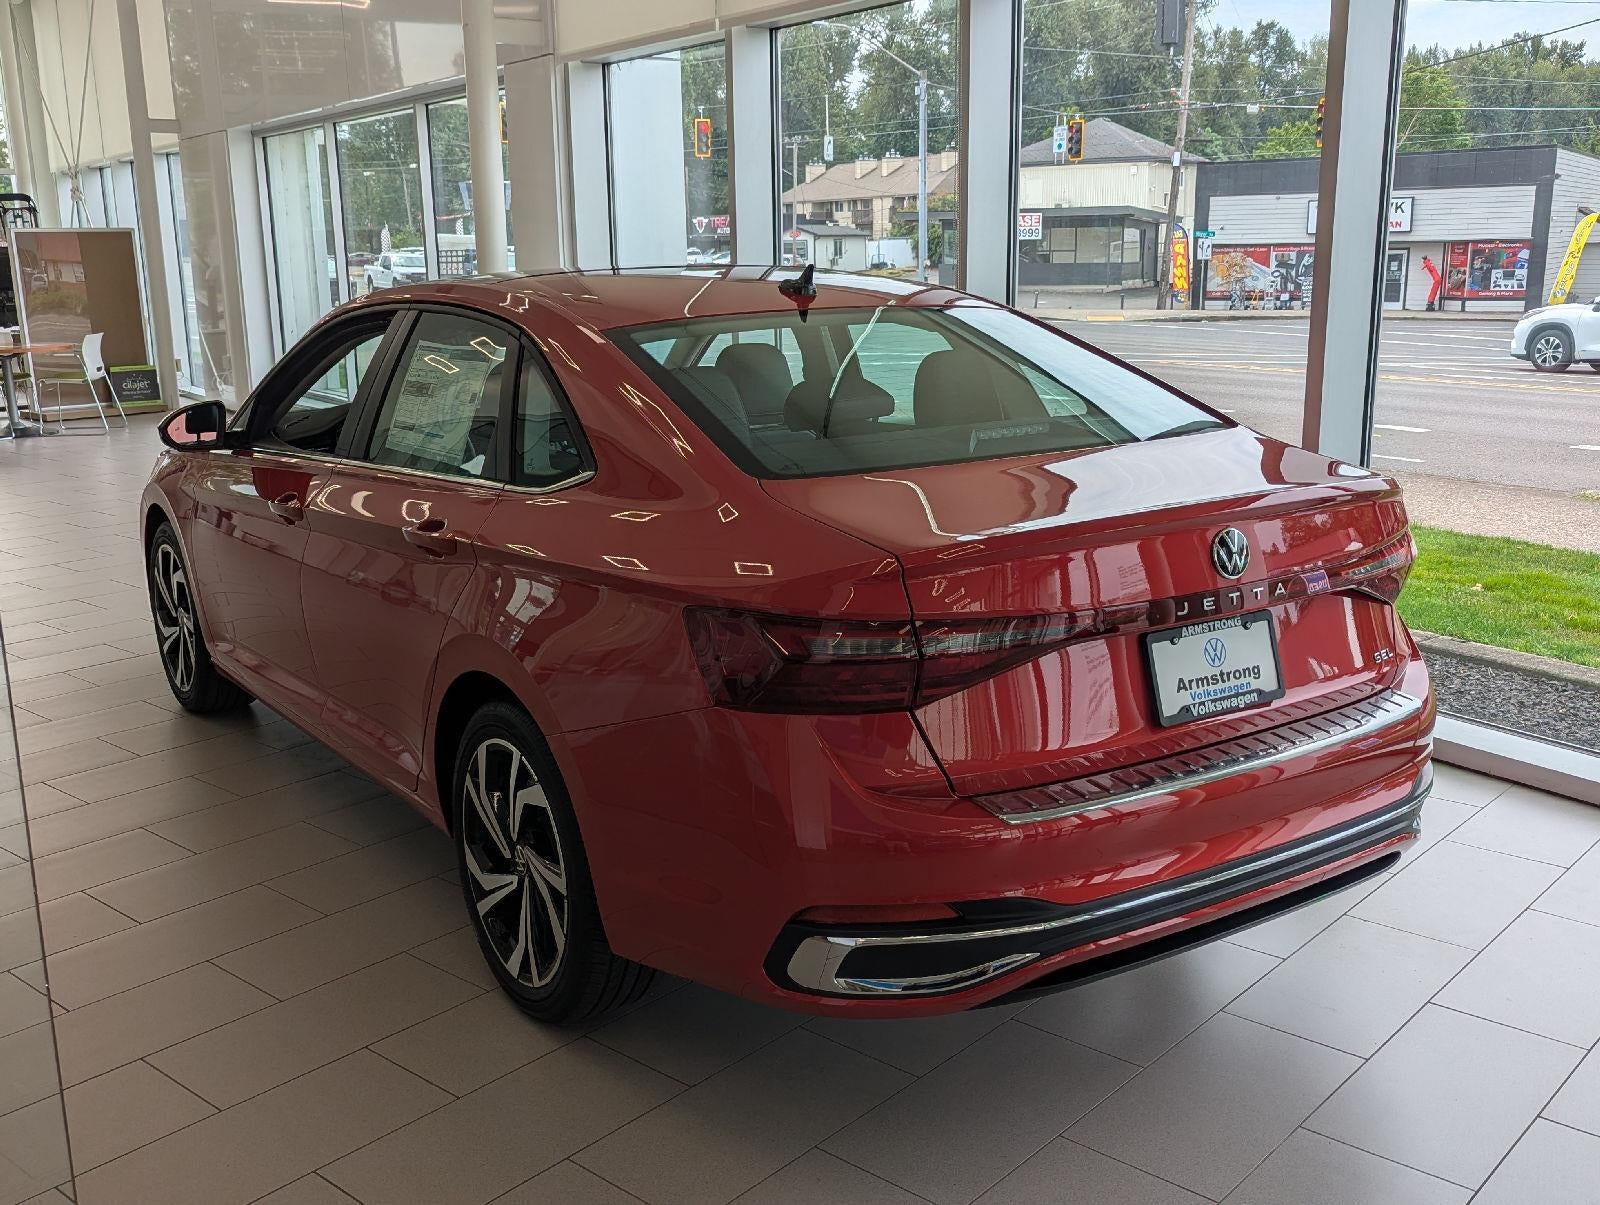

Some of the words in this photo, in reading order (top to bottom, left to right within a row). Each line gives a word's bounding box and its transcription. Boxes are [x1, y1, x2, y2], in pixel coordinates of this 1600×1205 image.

[1391, 201, 1405, 213] K
[1177, 583, 1287, 616] JETTA
[1181, 617, 1241, 638] ARMSTRONG
[1374, 648, 1393, 664] SEL
[1176, 664, 1261, 693] Armstrong
[1190, 681, 1252, 701] Volkswagen
[1190, 692, 1259, 717] Volkswagen
